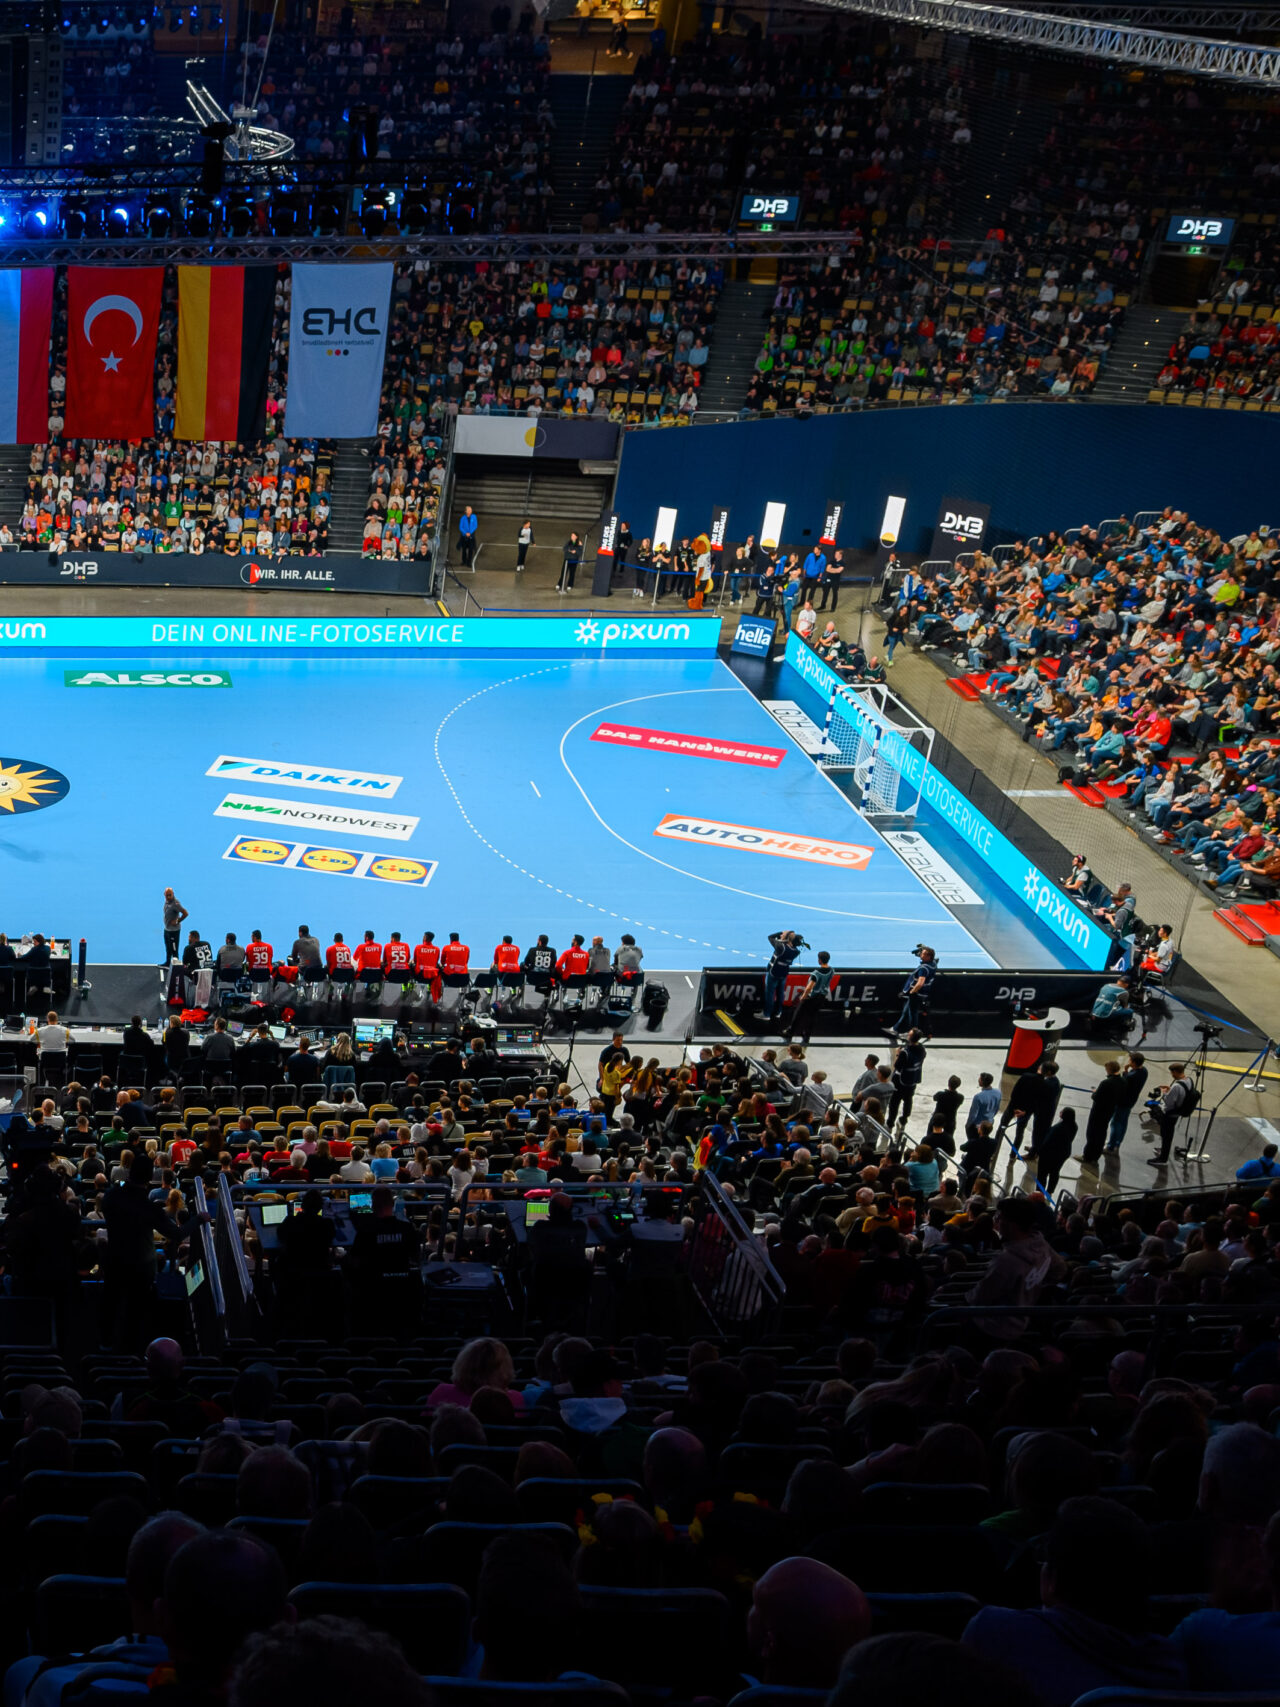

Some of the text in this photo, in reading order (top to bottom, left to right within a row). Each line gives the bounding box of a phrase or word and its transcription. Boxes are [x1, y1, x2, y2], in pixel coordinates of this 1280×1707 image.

[749, 199, 789, 214] DHB
[1177, 219, 1222, 236] DHB
[939, 511, 984, 534] DHB
[60, 561, 98, 575] DHB
[255, 569, 335, 581] WIR. IHR. ALLE.
[152, 624, 465, 643] DEIN ONLINE-FOTOSERVICE
[603, 623, 690, 647] pixum
[735, 624, 771, 646] hella
[803, 656, 836, 694] pixum
[597, 728, 779, 762] DAS HANDWERK
[251, 767, 391, 790] DAIKIN
[283, 809, 413, 832] NORDWEST
[666, 822, 862, 861] AUTOHERO
[898, 846, 966, 904] travelite
[1035, 886, 1090, 949] pixum
[194, 944, 209, 952] EGYPT
[196, 950, 212, 962] 92
[336, 951, 351, 963] 80
[391, 951, 407, 963] 55
[253, 952, 269, 964] 39
[535, 955, 551, 968] 88
[713, 983, 761, 1001] WIR.
[994, 986, 1036, 1000] DHB
